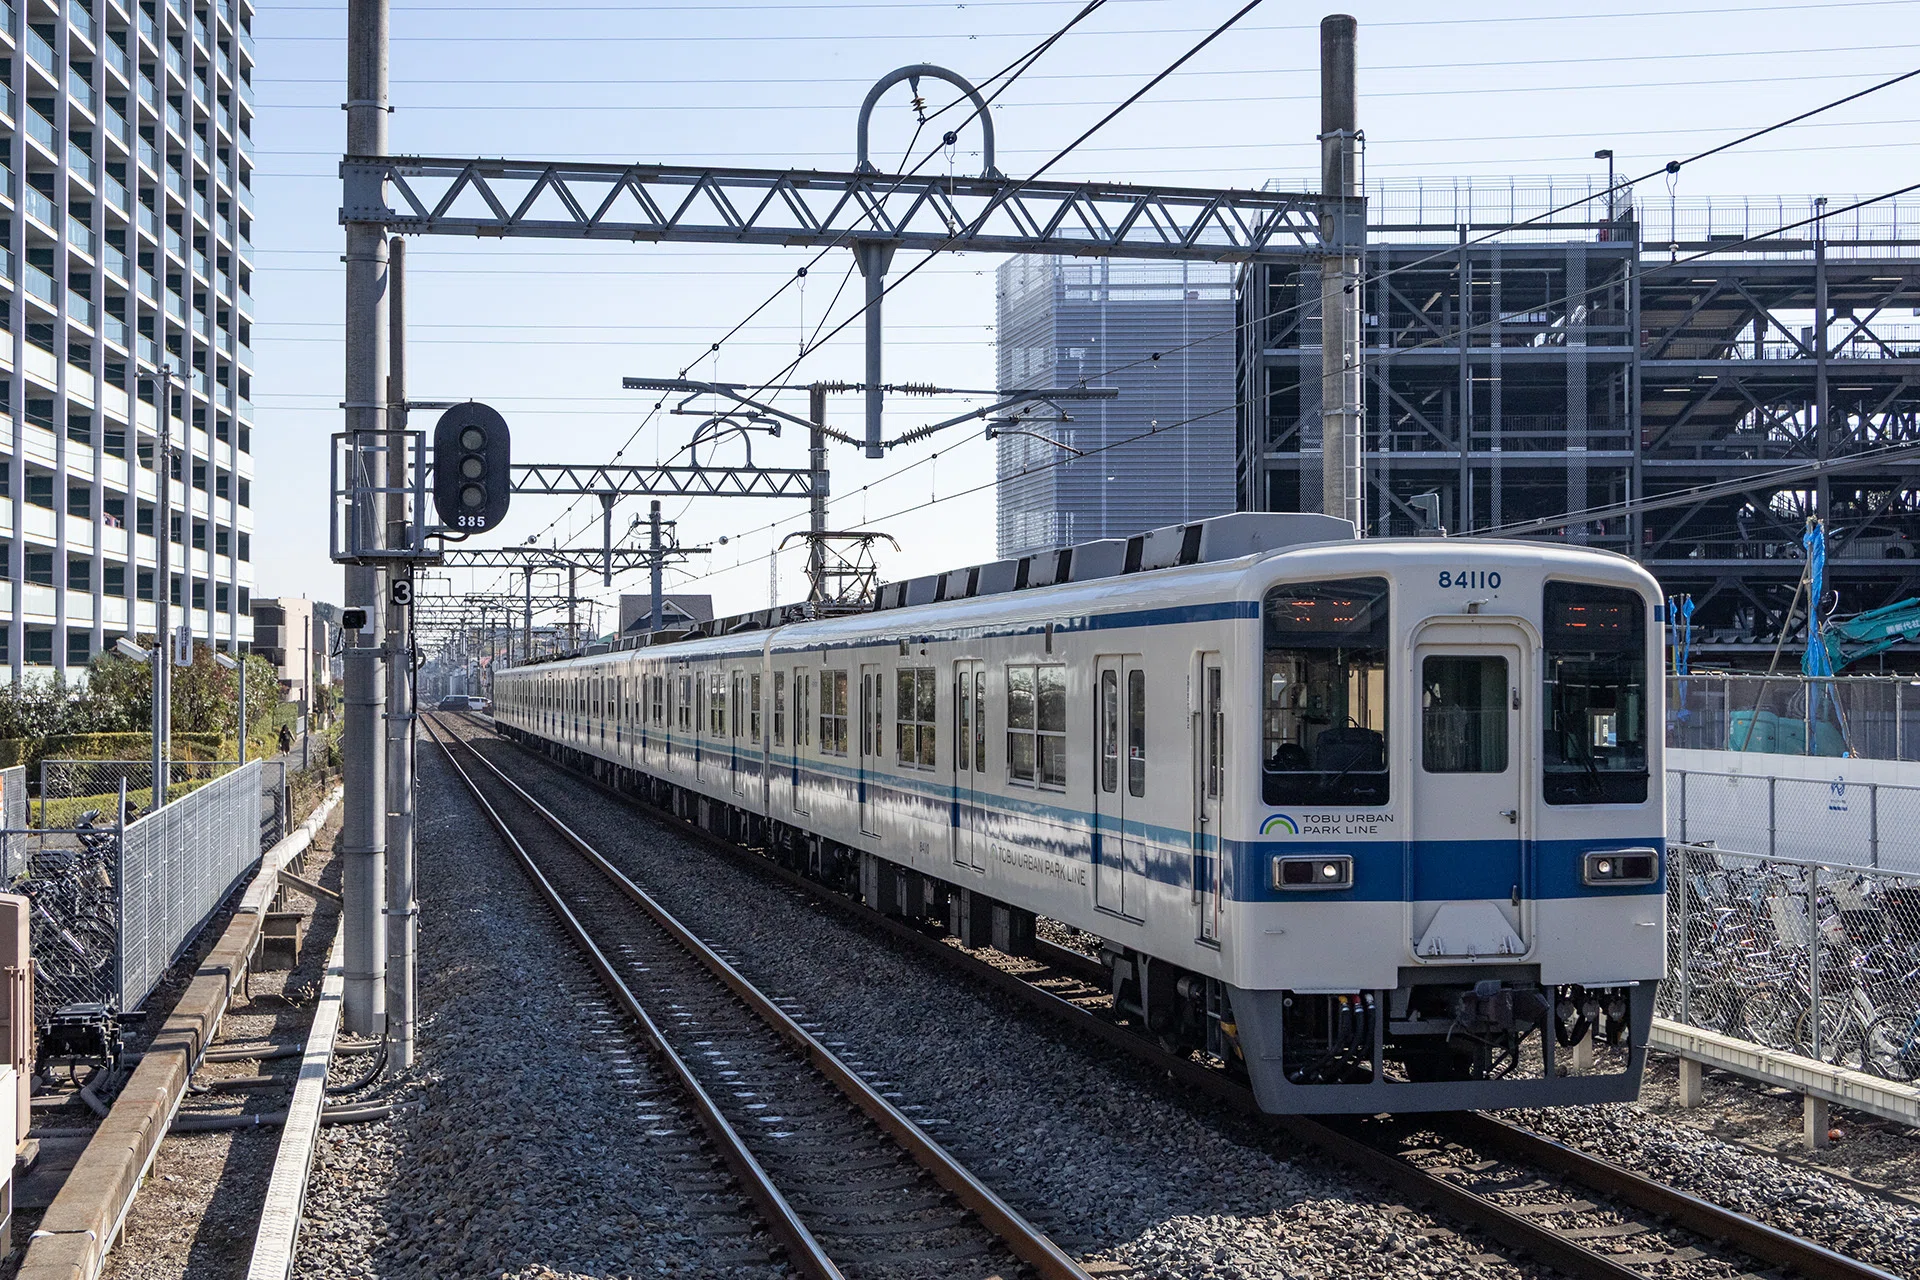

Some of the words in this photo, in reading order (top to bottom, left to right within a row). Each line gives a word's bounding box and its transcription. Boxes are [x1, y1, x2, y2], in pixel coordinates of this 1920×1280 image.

[458, 515, 485, 527] 385
[1438, 570, 1502, 589] 84110
[394, 580, 412, 605] 3
[1303, 814, 1341, 823] TOBU
[1345, 814, 1394, 823] URBAN
[1303, 826, 1341, 834] PARK
[1345, 825, 1378, 834] LINE
[998, 847, 1017, 866] TOBU
[1018, 852, 1043, 874] URBAN
[1044, 860, 1066, 881] PARK
[1067, 865, 1086, 886] LINE
